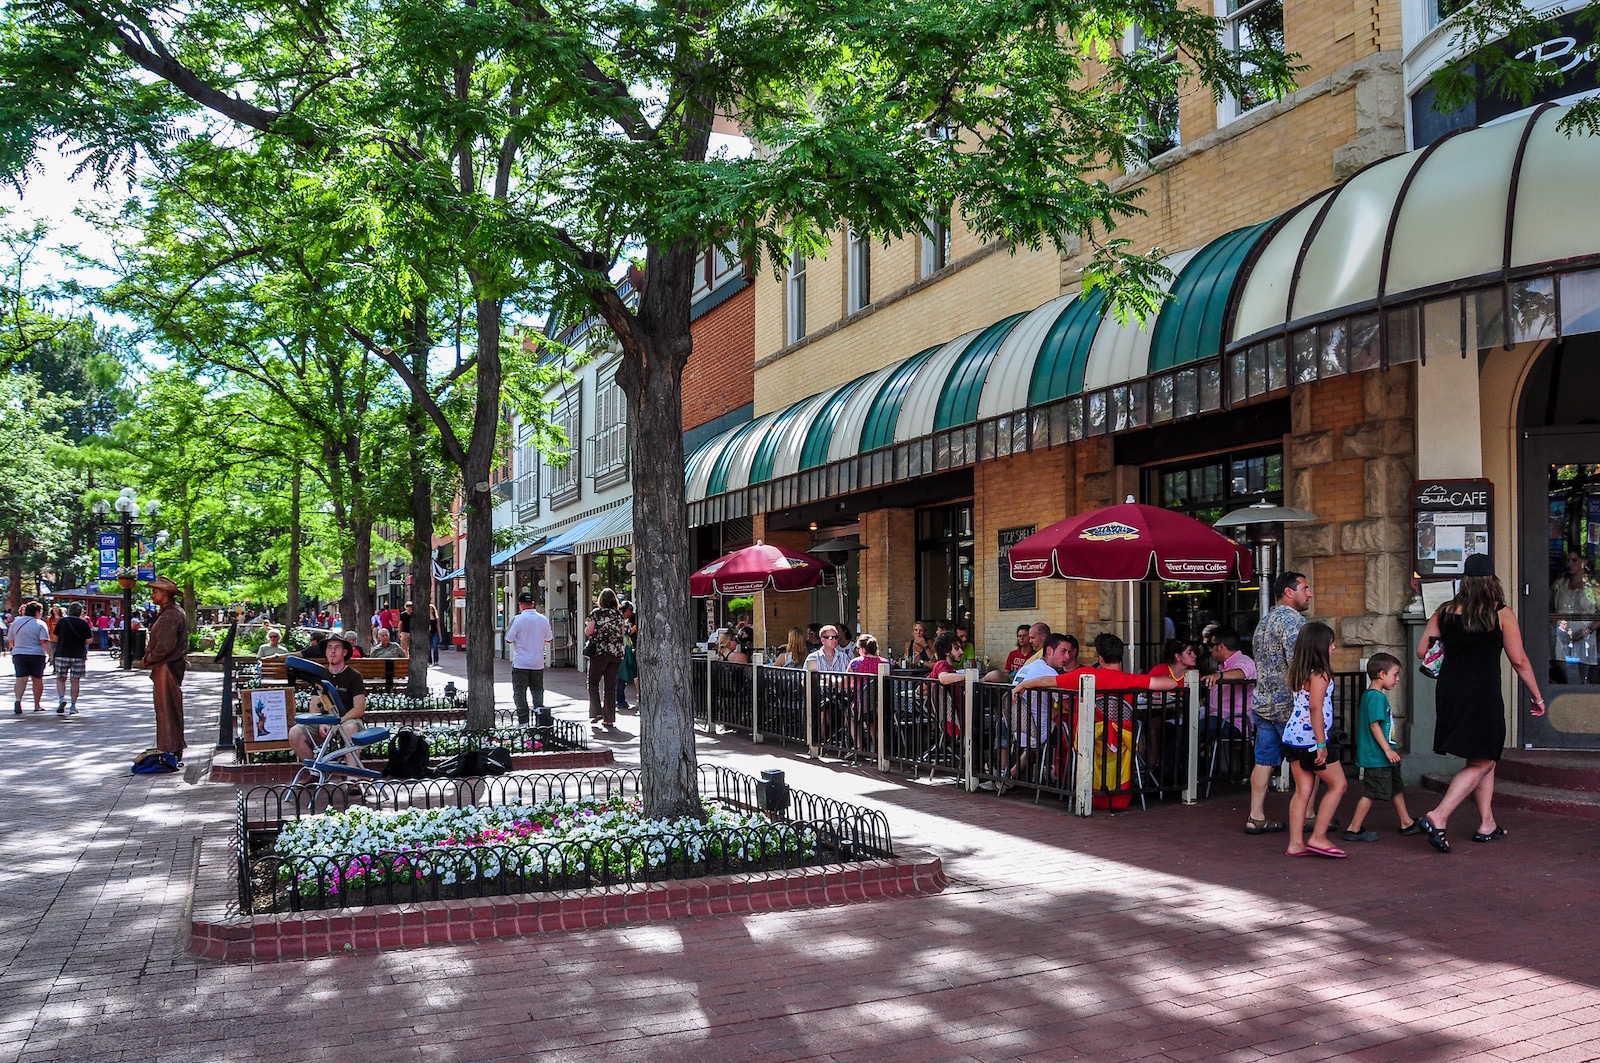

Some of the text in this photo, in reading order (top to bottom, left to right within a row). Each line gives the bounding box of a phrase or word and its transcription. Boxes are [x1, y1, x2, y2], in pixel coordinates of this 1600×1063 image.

[1450, 491, 1487, 506] CAFE
[1001, 531, 1016, 544] TOP
[1182, 563, 1204, 572] Canyon
[1205, 563, 1227, 571] Coffee
